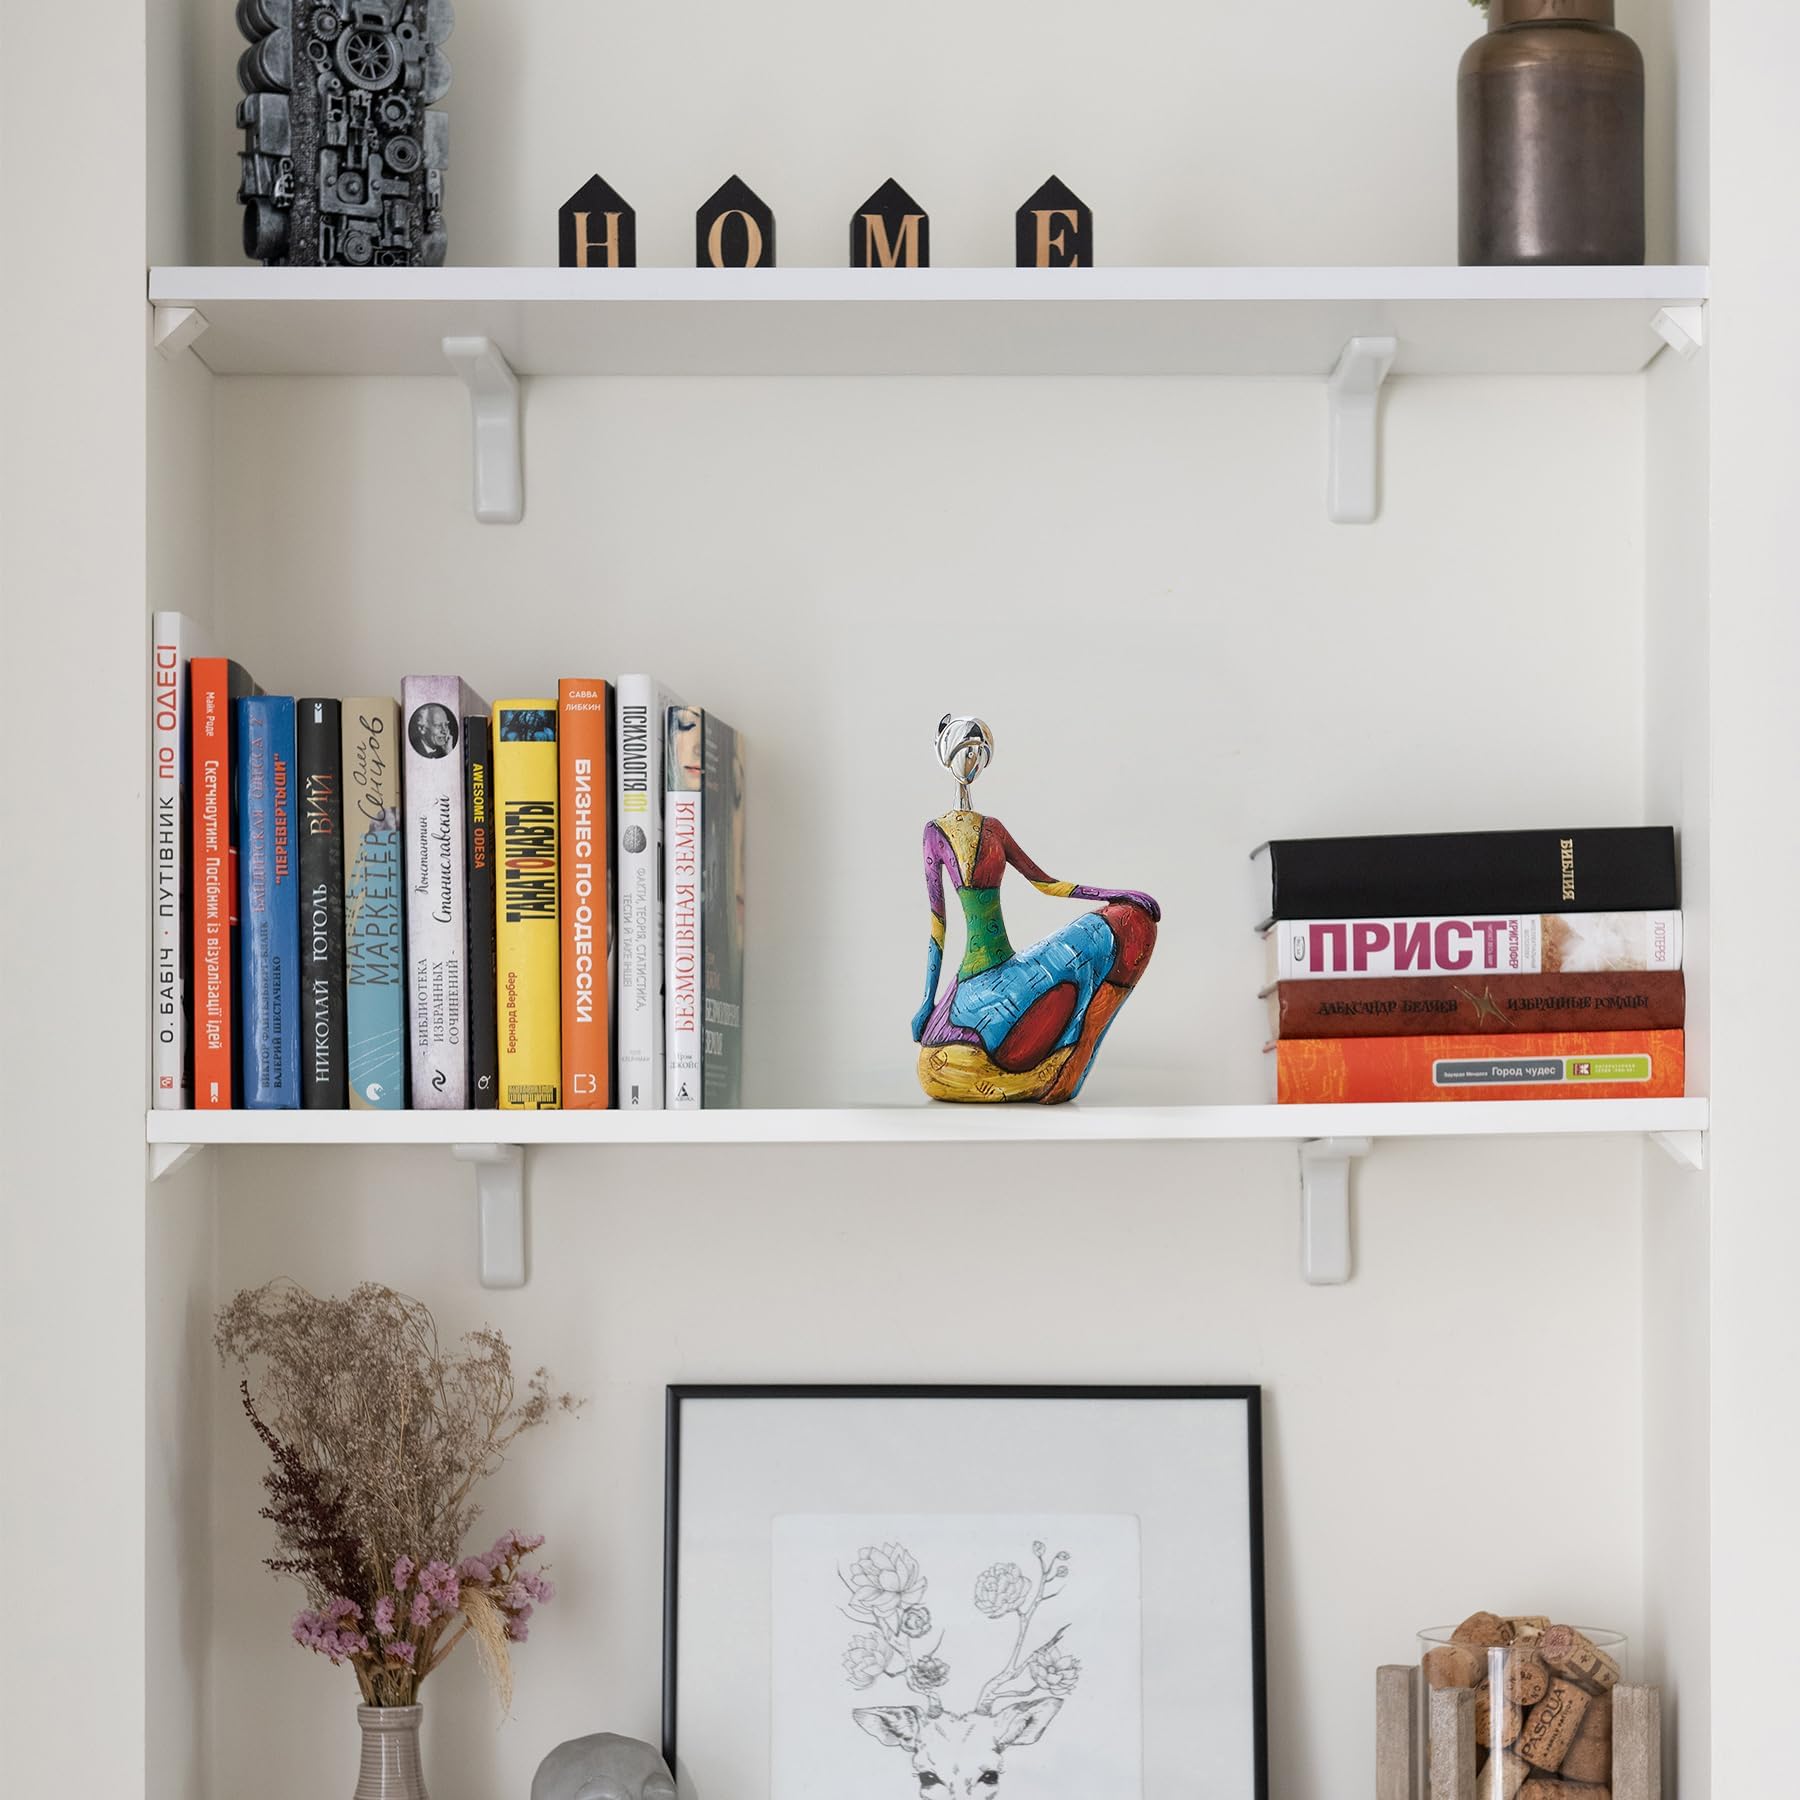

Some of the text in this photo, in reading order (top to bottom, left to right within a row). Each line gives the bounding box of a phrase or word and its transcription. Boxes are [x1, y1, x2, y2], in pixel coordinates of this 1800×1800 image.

[156, 645, 177, 730] ОДЕСІ
[204, 692, 216, 737] Майк Роде
[565, 703, 601, 711] ЛИБКИН
[568, 690, 598, 698] САВВА
[159, 746, 174, 779] ПО
[472, 763, 484, 870] AWESOME ODESA
[159, 797, 174, 918] ПУТІВНИК
[574, 758, 593, 1024] БИЗНЕС ПО-ОДЕССКИ
[1560, 838, 1575, 901] БИБЛИЯ
[204, 760, 224, 1049] Скетчноутинг. Посібник із візуалізації ідей
[364, 832, 389, 985] МАРКЕТЕР
[675, 801, 696, 1032] БЕЗМОЛВНАЯ ЗЕМЛЯ
[1654, 921, 1665, 962] ЛОТЕРЕЯ
[159, 947, 174, 1014] БАБІЧ
[1309, 920, 1507, 972] ПРИСТ
[1508, 919, 1519, 969] КРИСТОФЕР
[313, 882, 330, 1083] НИКОЛАЙ ГОГОЛЬ
[417, 957, 429, 1047] БИБЛИОТЕКА
[433, 961, 444, 1043] ИЗБРАННЫХ
[506, 971, 517, 1055] Бернард Вербер
[1491, 1064, 1556, 1077] Город чудес
[1521, 1688, 1565, 1759] PASQUA
